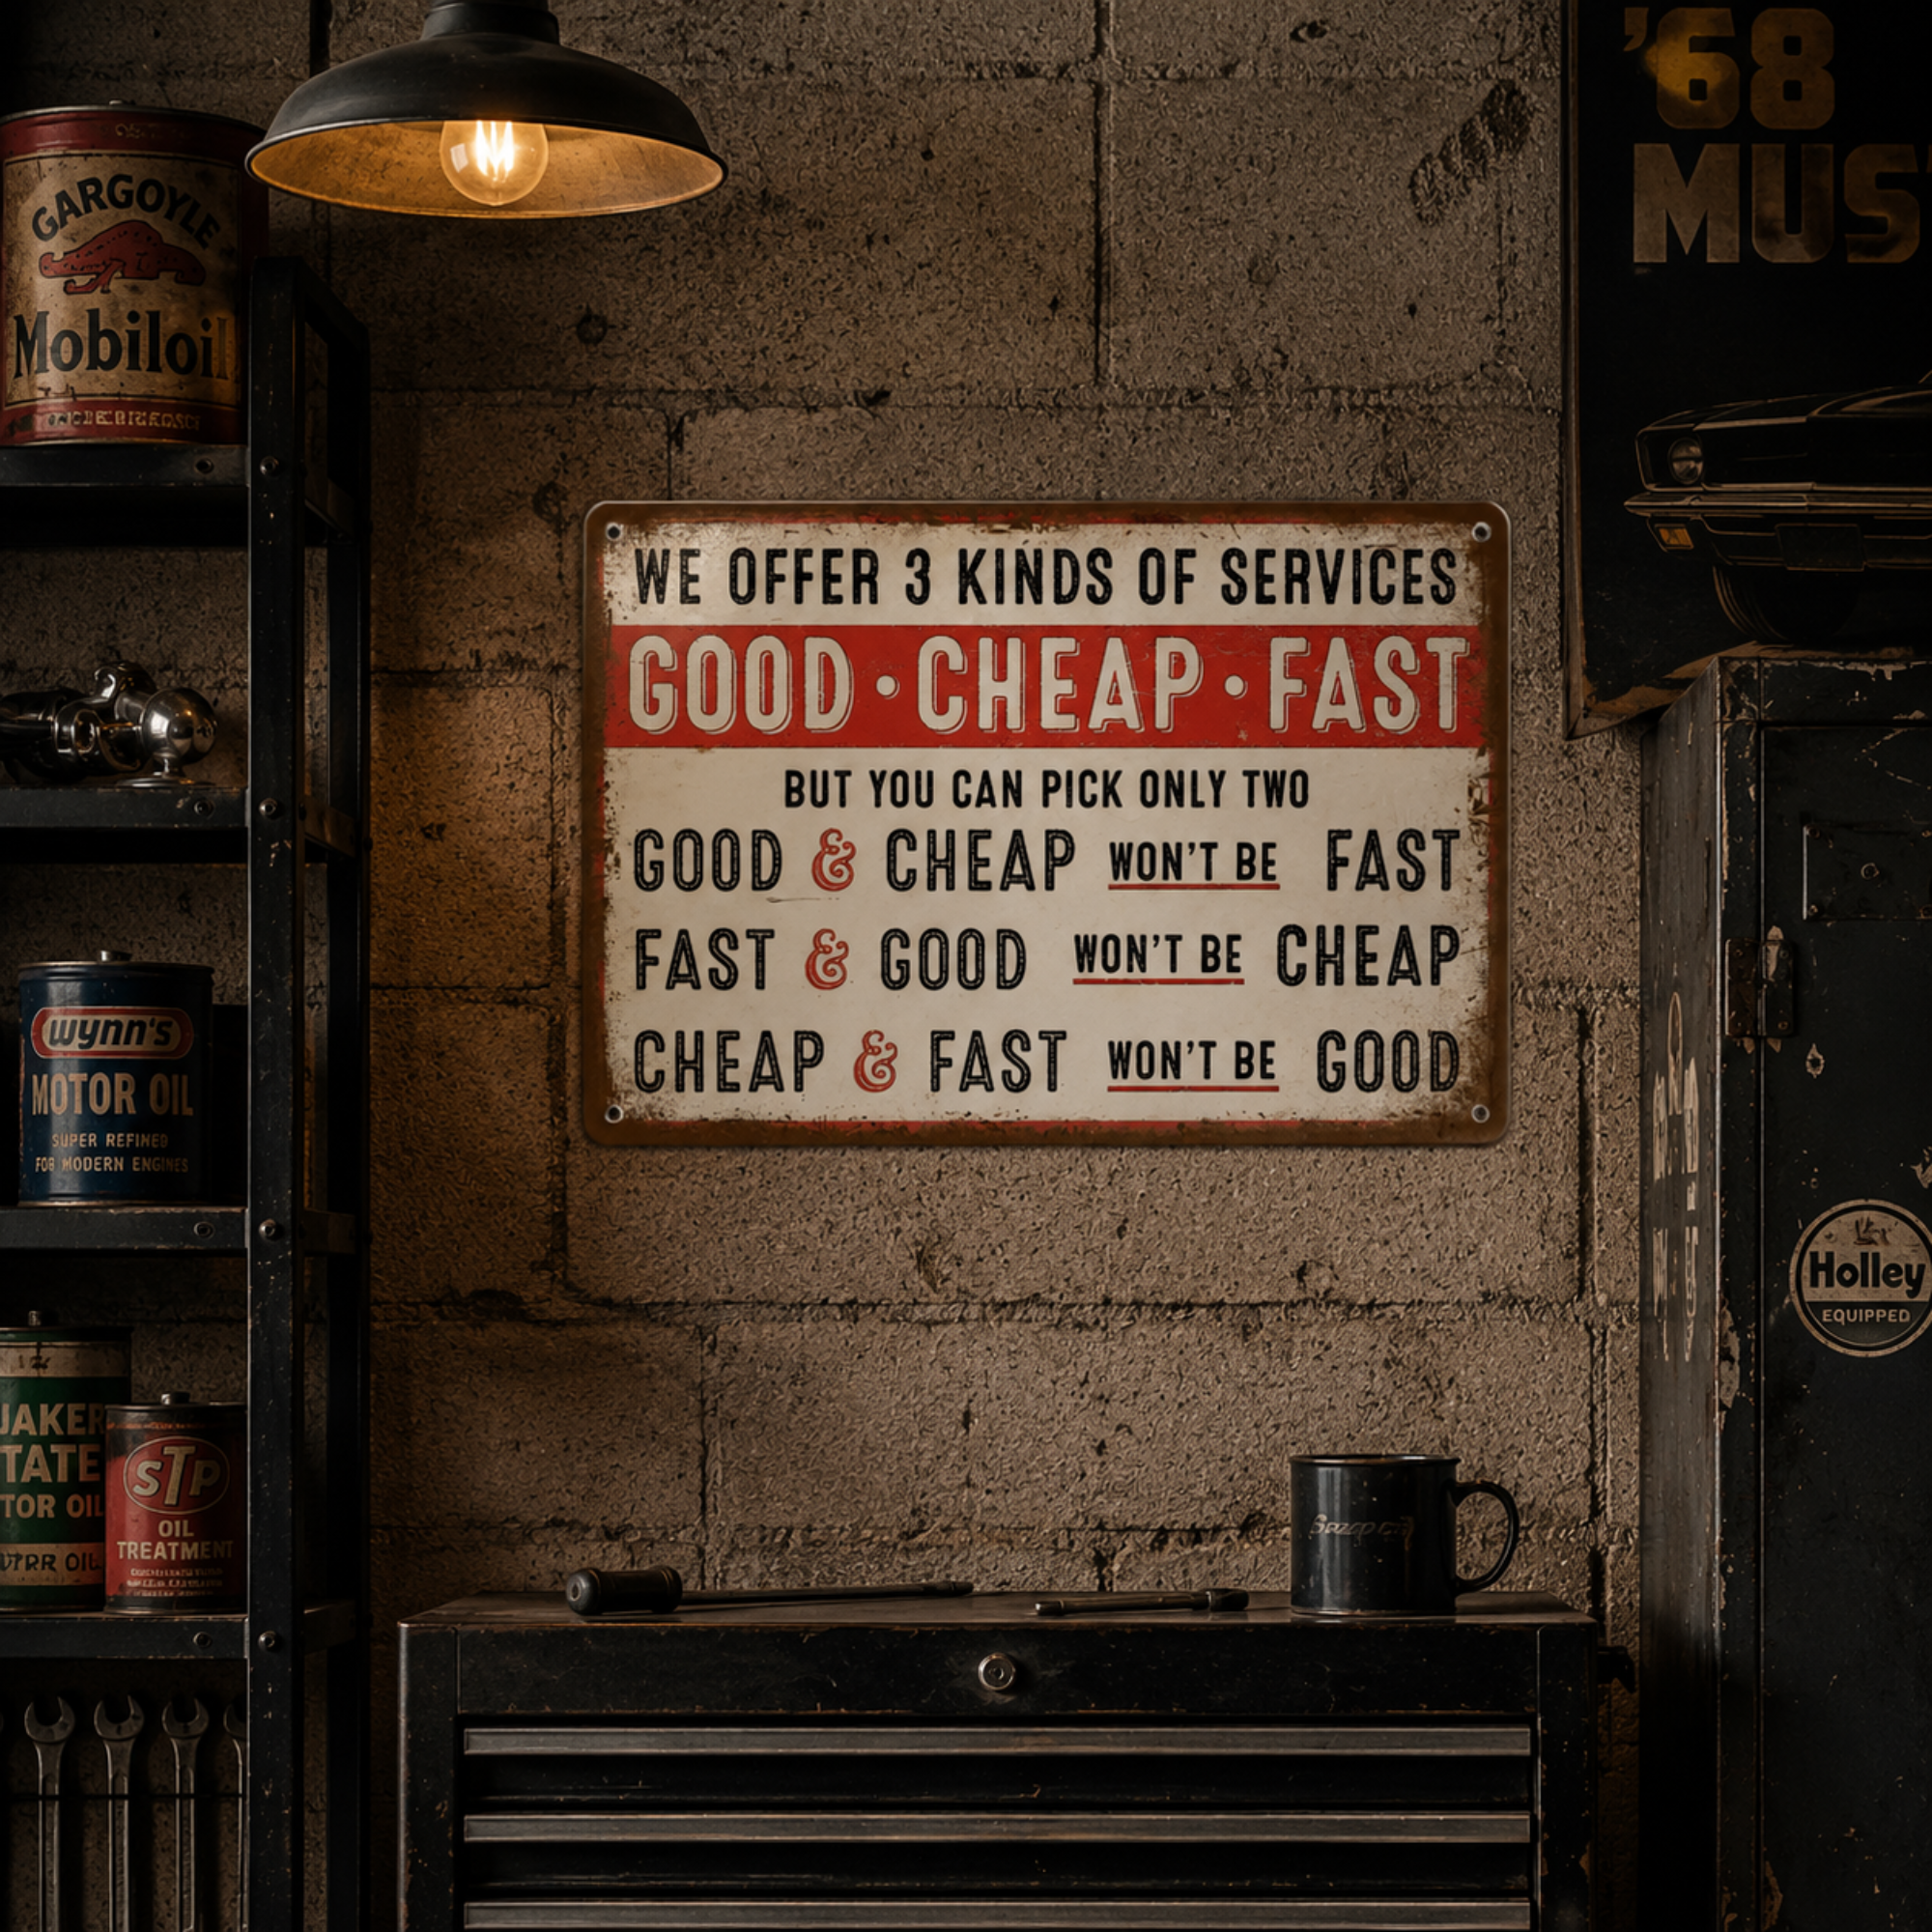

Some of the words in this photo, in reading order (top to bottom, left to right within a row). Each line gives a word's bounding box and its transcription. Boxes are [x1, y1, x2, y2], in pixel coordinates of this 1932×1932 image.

[1623, 7, 1835, 129] '68
[31, 174, 221, 249] GARGOYLE
[1633, 143, 1932, 263] MUS
[14, 308, 229, 380] Mobiloil
[635, 548, 702, 606] WE
[727, 547, 880, 606] OFFER
[904, 547, 931, 606] 3
[957, 547, 1114, 606] KINDS
[1138, 547, 1198, 606] OF
[1220, 547, 1458, 606] SERVICES
[628, 634, 855, 734] GOOD
[917, 634, 1205, 734] CHEAP
[1268, 634, 1471, 734] FAST
[783, 769, 853, 809] BUT
[868, 769, 935, 809] YOU
[951, 769, 1024, 809] CAN
[1041, 769, 1123, 809] PICK
[1138, 769, 1227, 809] ONLY
[1242, 769, 1310, 809] TWO
[633, 828, 783, 893] GOOD
[810, 827, 857, 893] &
[886, 828, 1076, 893] CHEAP
[1108, 841, 1219, 882] WON'T
[1236, 841, 1277, 882] BE
[1326, 828, 1461, 893] FAST
[635, 928, 776, 991] FAST
[804, 927, 850, 991] &
[880, 928, 1028, 991] GOOD
[1073, 933, 1183, 974] WON'T
[1200, 933, 1242, 974] BE
[1276, 923, 1462, 987] CHEAP
[634, 1029, 825, 1094] CHEAP
[852, 1029, 898, 1094] &
[929, 1029, 1067, 1094] FAST
[1107, 1039, 1217, 1080] WON'T
[1234, 1039, 1276, 1080] BE
[1317, 1029, 1461, 1094] GOOD
[31, 1072, 137, 1116] MOTOR
[149, 1072, 194, 1117] OIL
[51, 1132, 98, 1149] SUPER
[61, 1156, 125, 1173] MODERN
[1809, 1251, 1926, 1299] Holley
[1822, 1308, 1912, 1326] EQUIPPED
[131, 1445, 221, 1507] STP
[65, 1492, 104, 1520] OIL
[157, 1519, 195, 1538] OIL
[116, 1540, 234, 1561] TREATMENT
